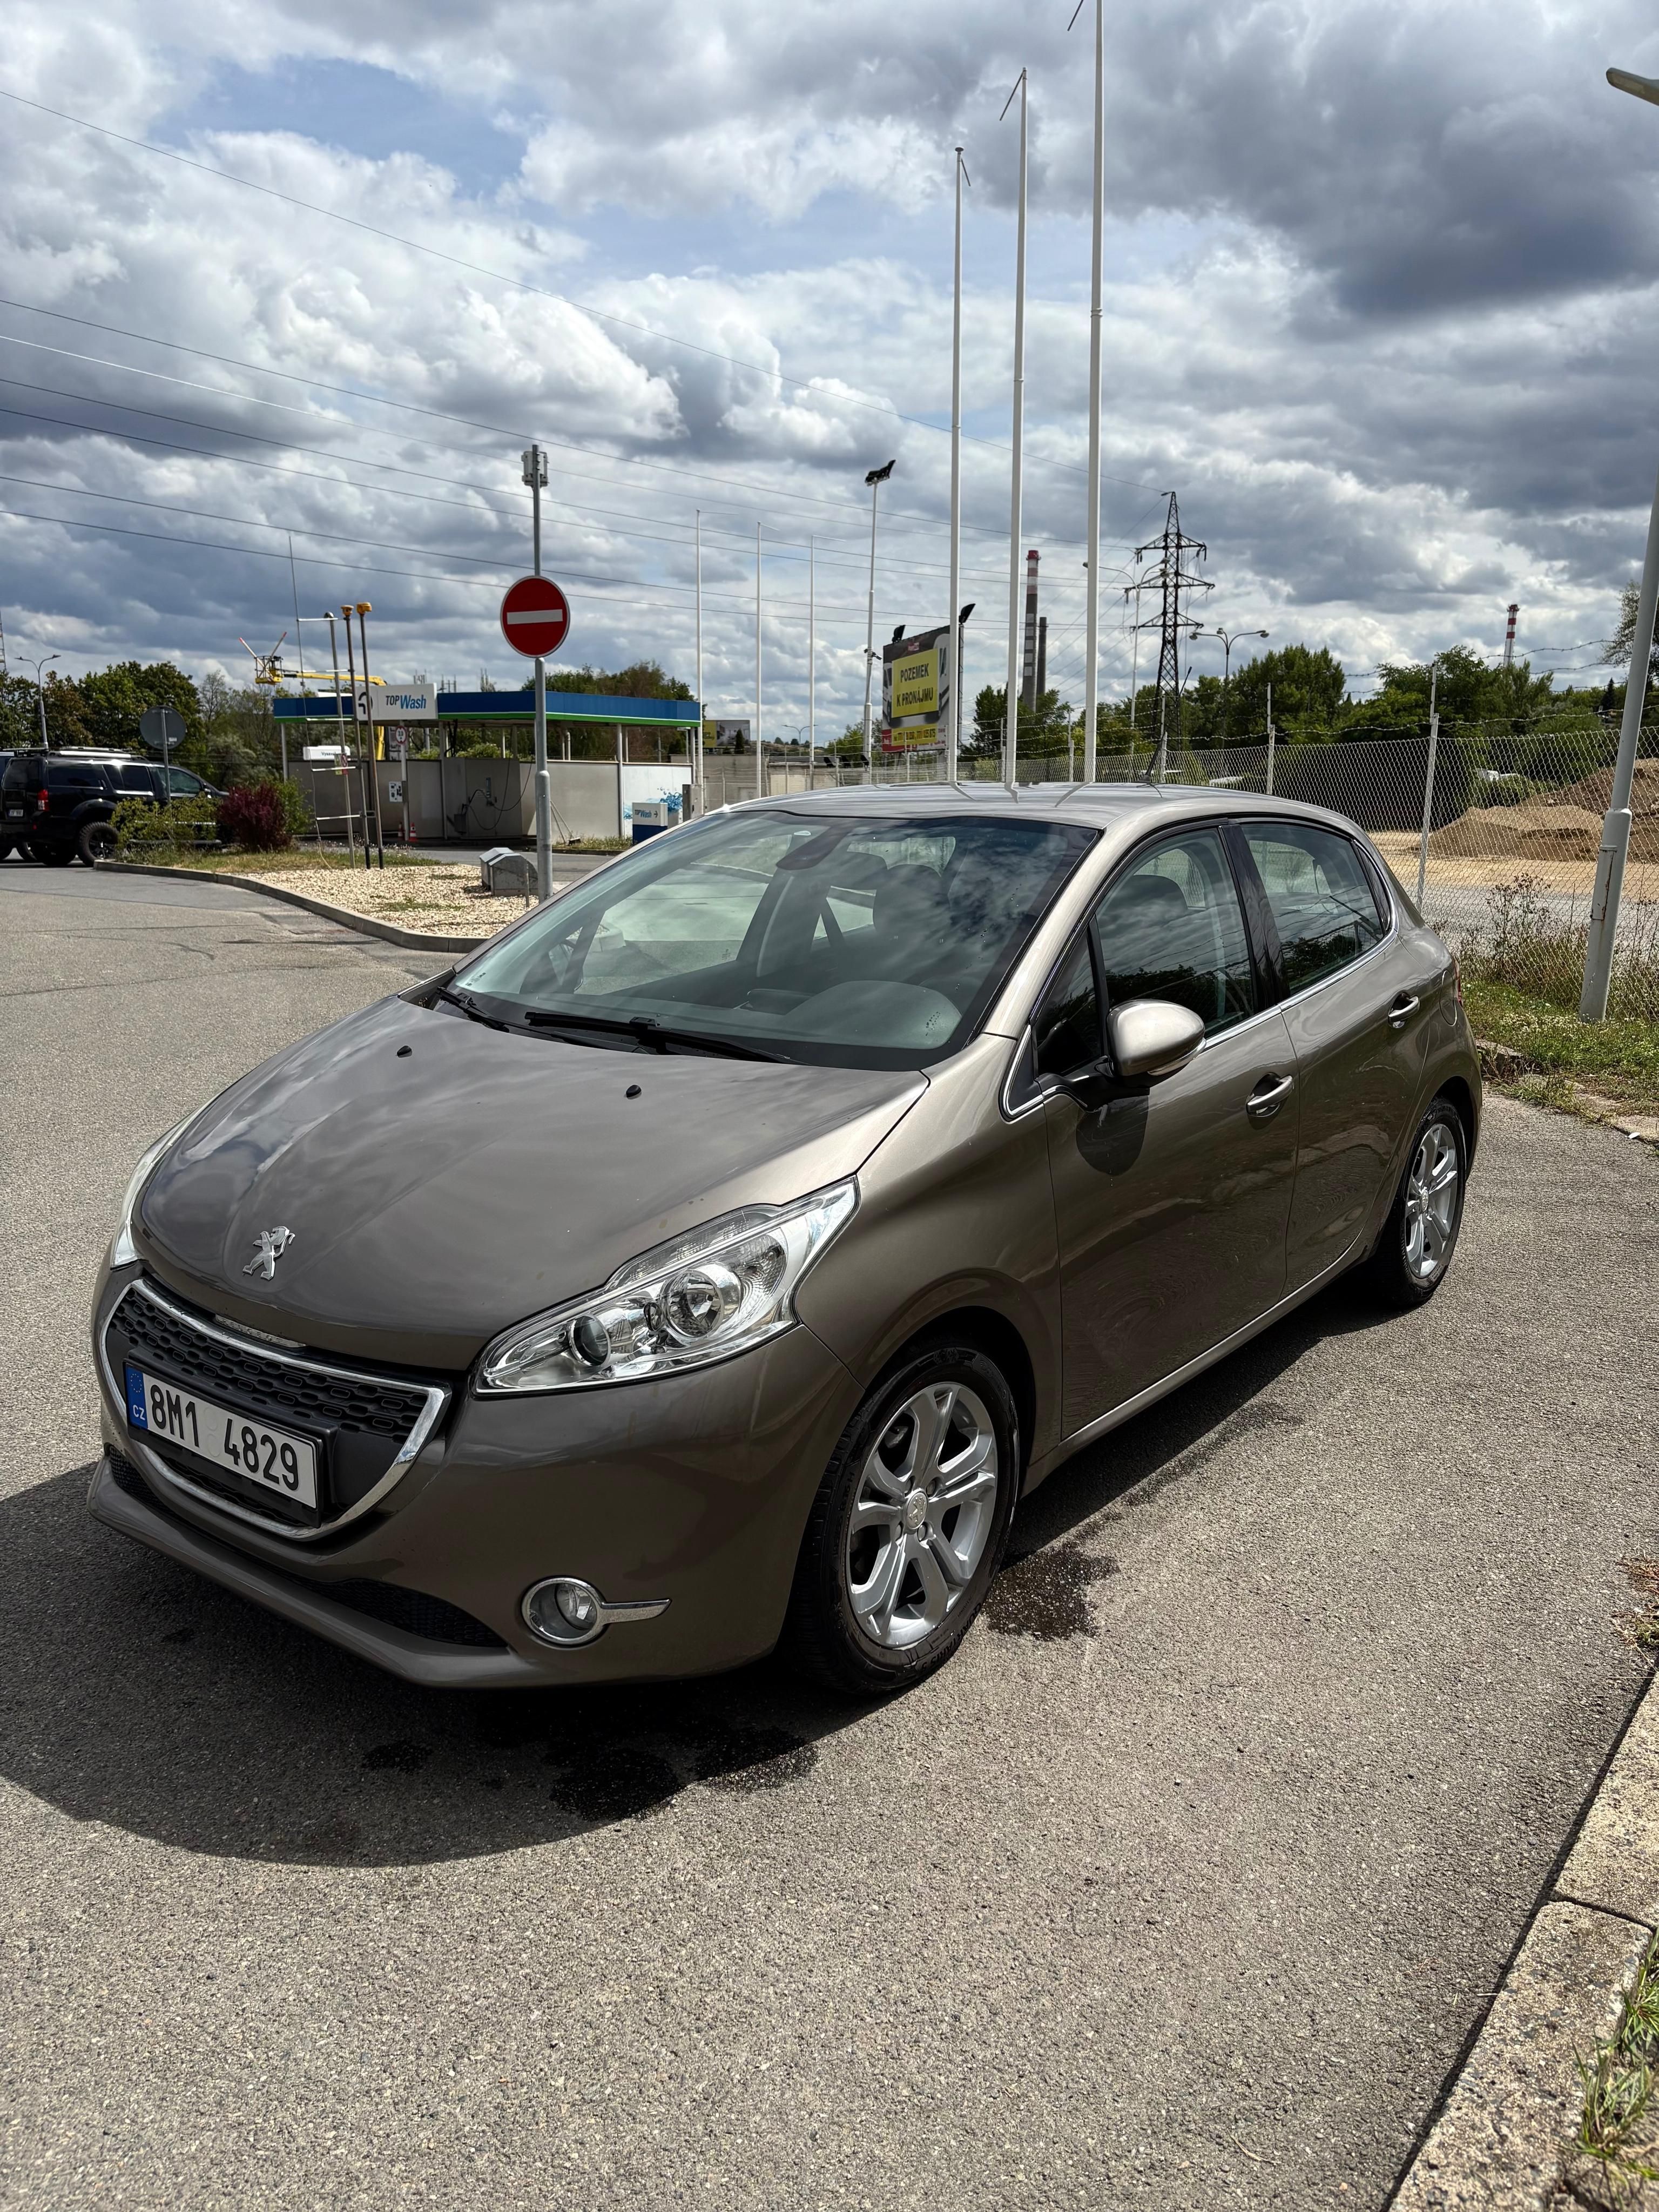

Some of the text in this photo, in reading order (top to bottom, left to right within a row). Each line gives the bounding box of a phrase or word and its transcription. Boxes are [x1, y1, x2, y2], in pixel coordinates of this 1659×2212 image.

[900, 663, 929, 683] POZEMEK
[896, 687, 933, 707] K PRONÁJMU
[132, 1404, 146, 1420] CZ
[150, 1384, 299, 1491] 8M1 4829
